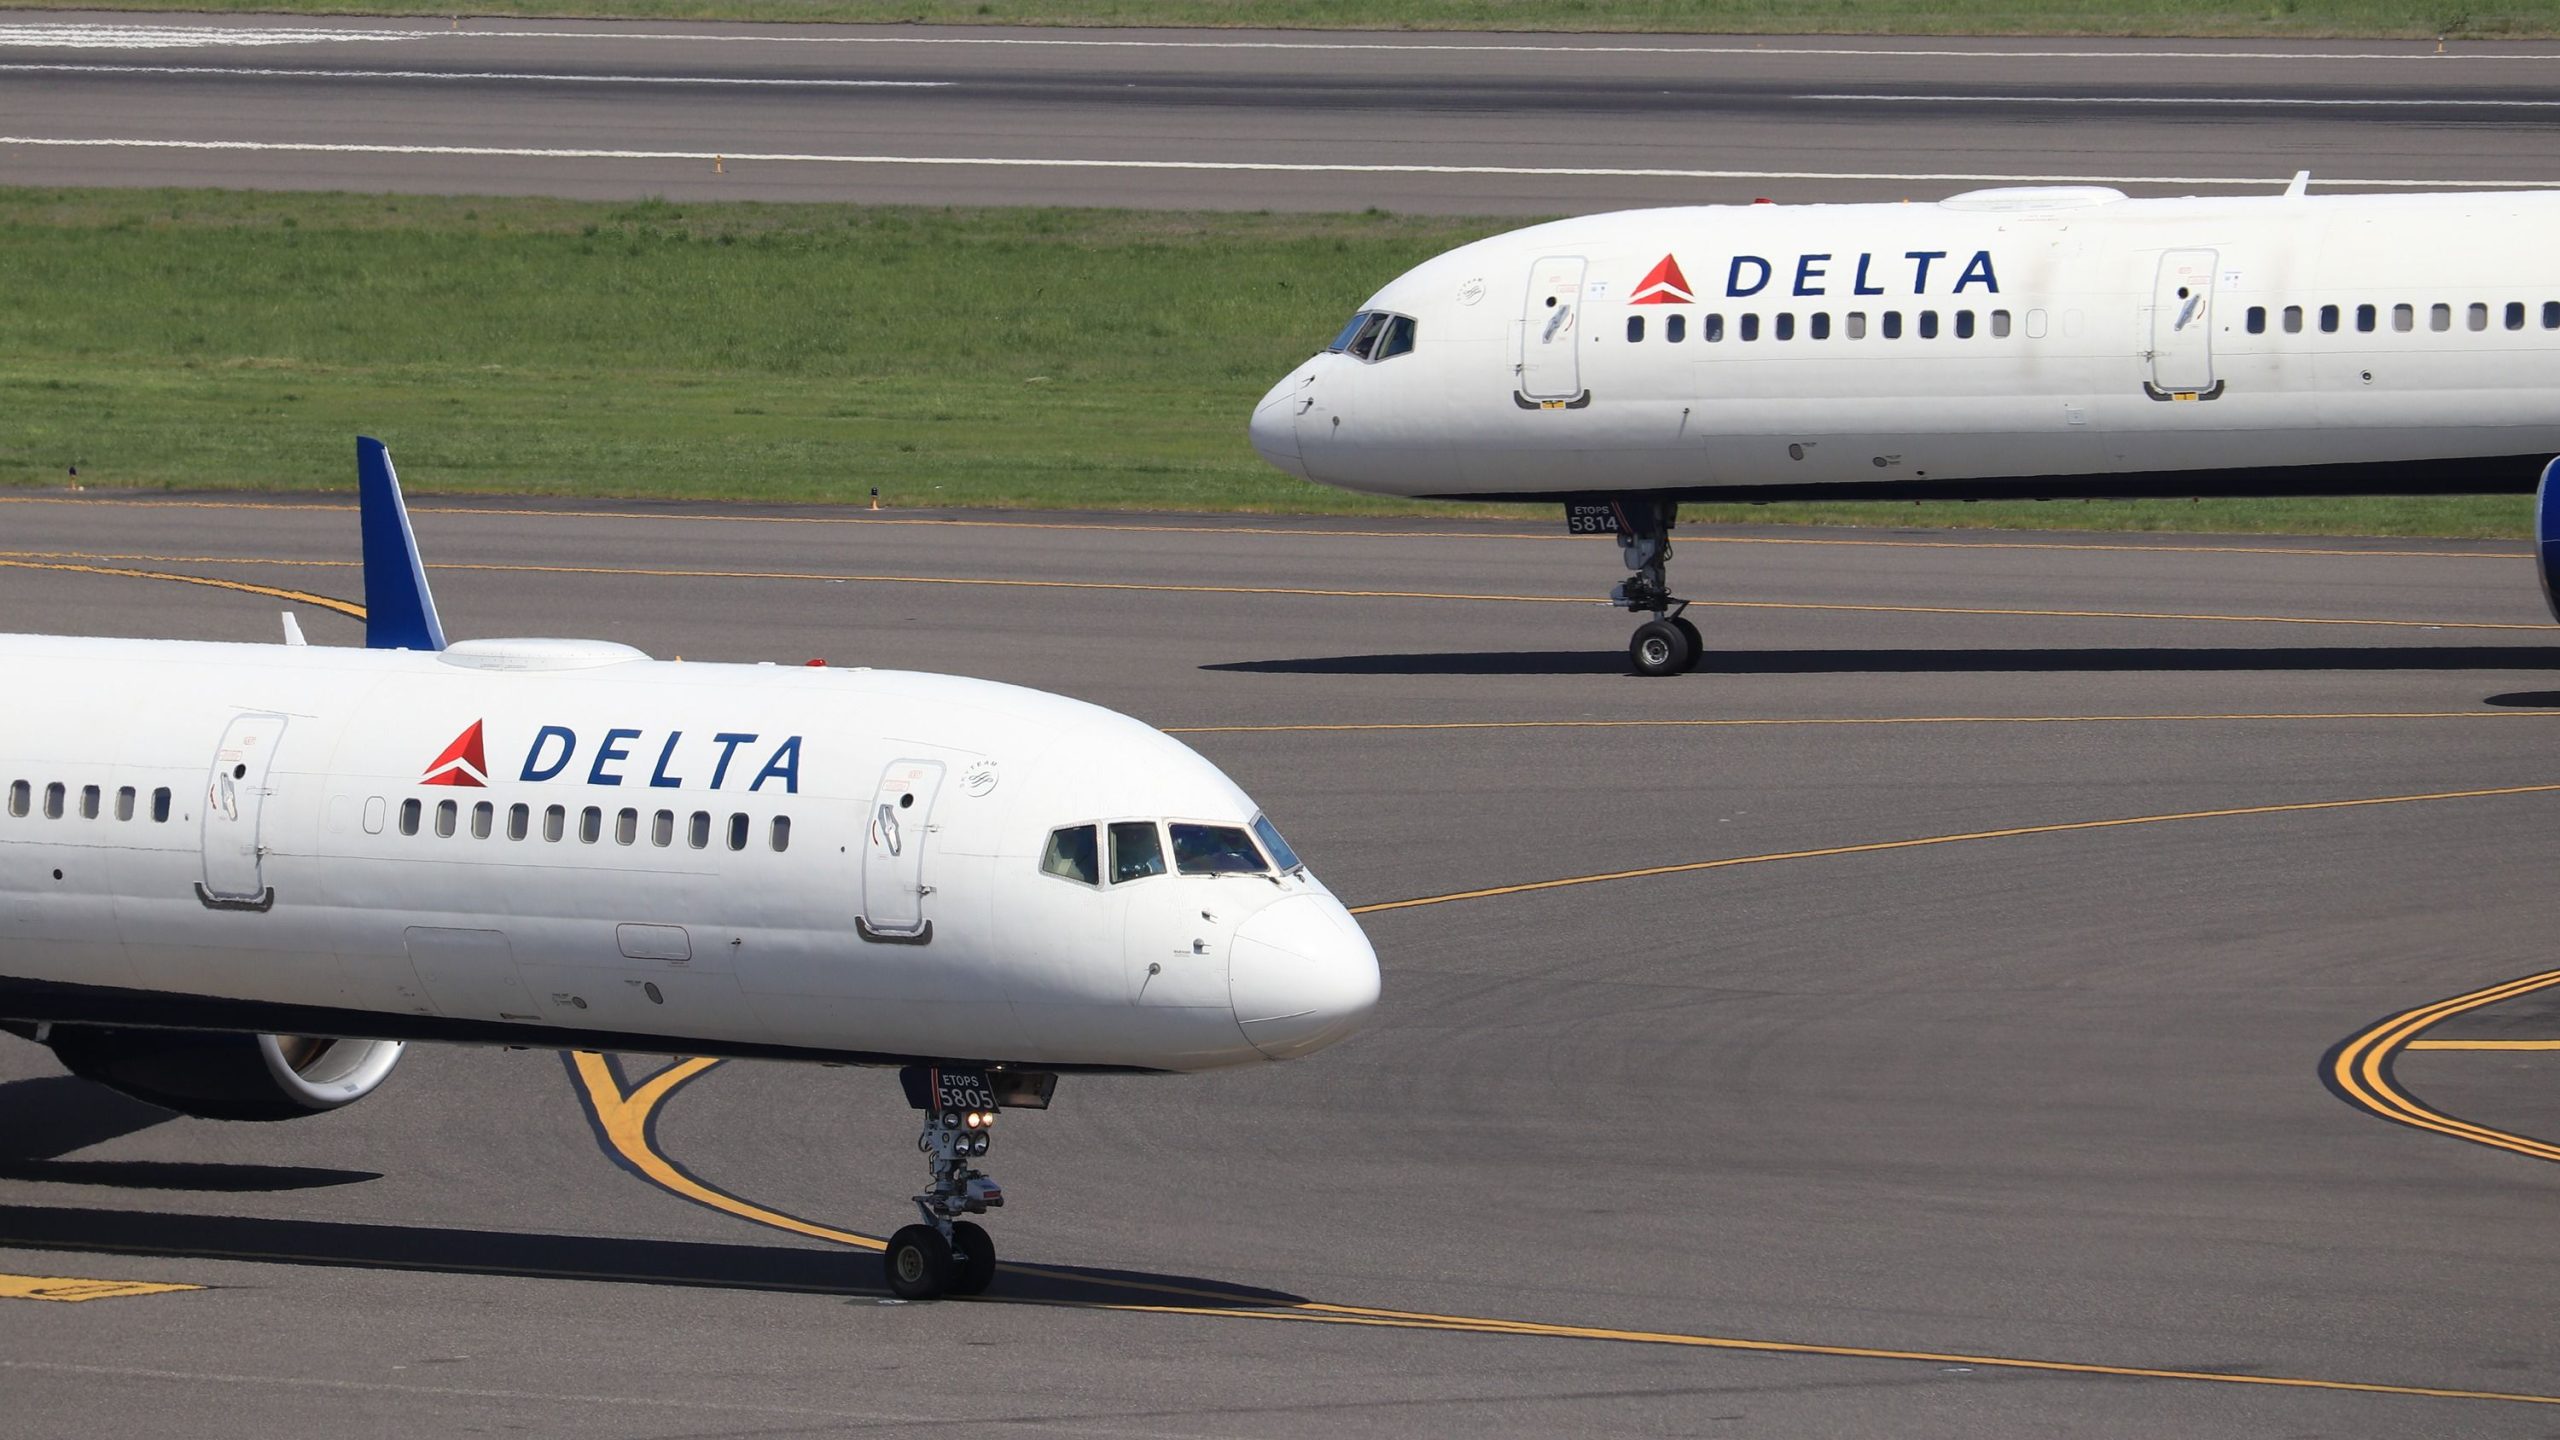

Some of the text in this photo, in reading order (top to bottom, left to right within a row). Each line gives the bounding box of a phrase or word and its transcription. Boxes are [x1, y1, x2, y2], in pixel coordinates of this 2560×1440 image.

[1726, 250, 1999, 298] DELTA
[1574, 506, 1610, 515] ETOPS
[1571, 516, 1619, 531] 5814
[519, 725, 802, 794] DELTA
[942, 1074, 979, 1087] ETOPS
[939, 1087, 994, 1109] 5805
